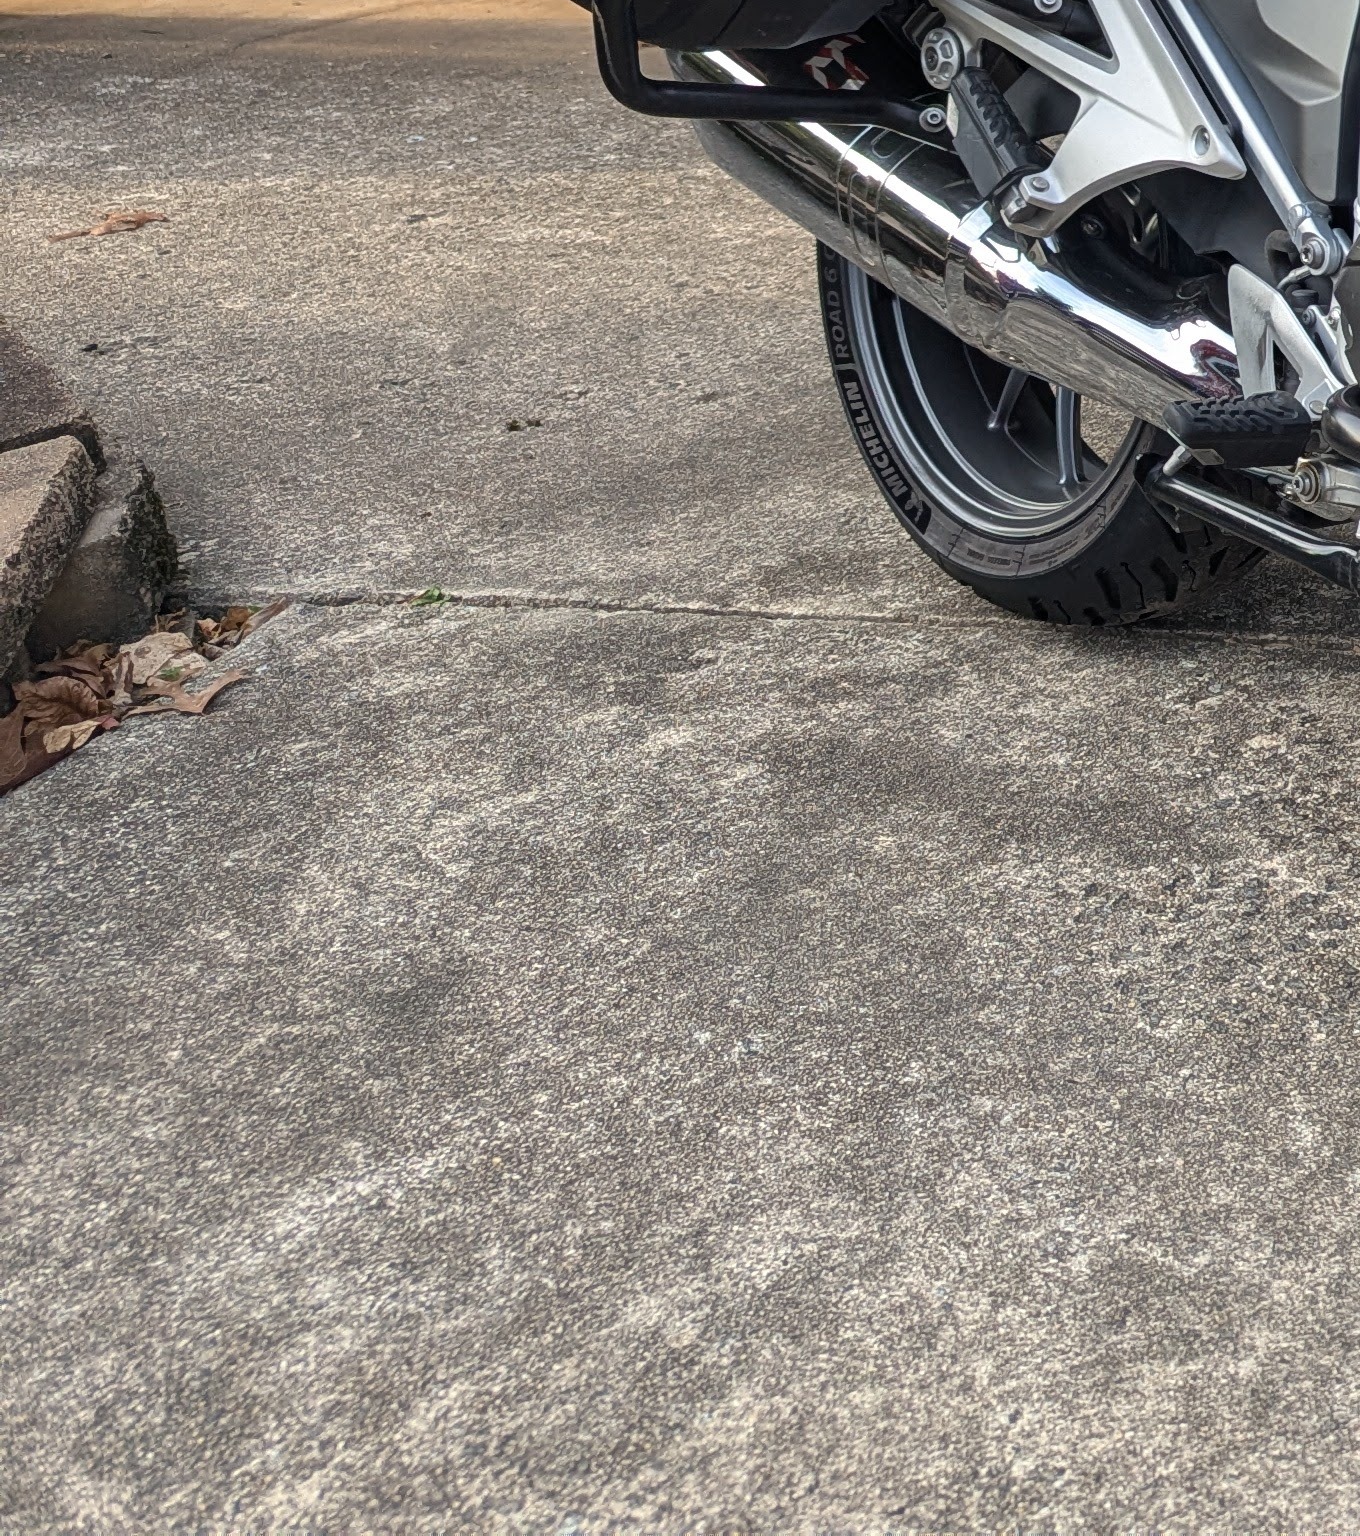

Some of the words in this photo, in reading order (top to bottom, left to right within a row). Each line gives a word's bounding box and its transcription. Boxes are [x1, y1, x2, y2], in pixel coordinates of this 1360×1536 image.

[824, 266, 838, 284] 6
[826, 290, 850, 358] ROAD
[843, 380, 909, 499] MICHELIN
